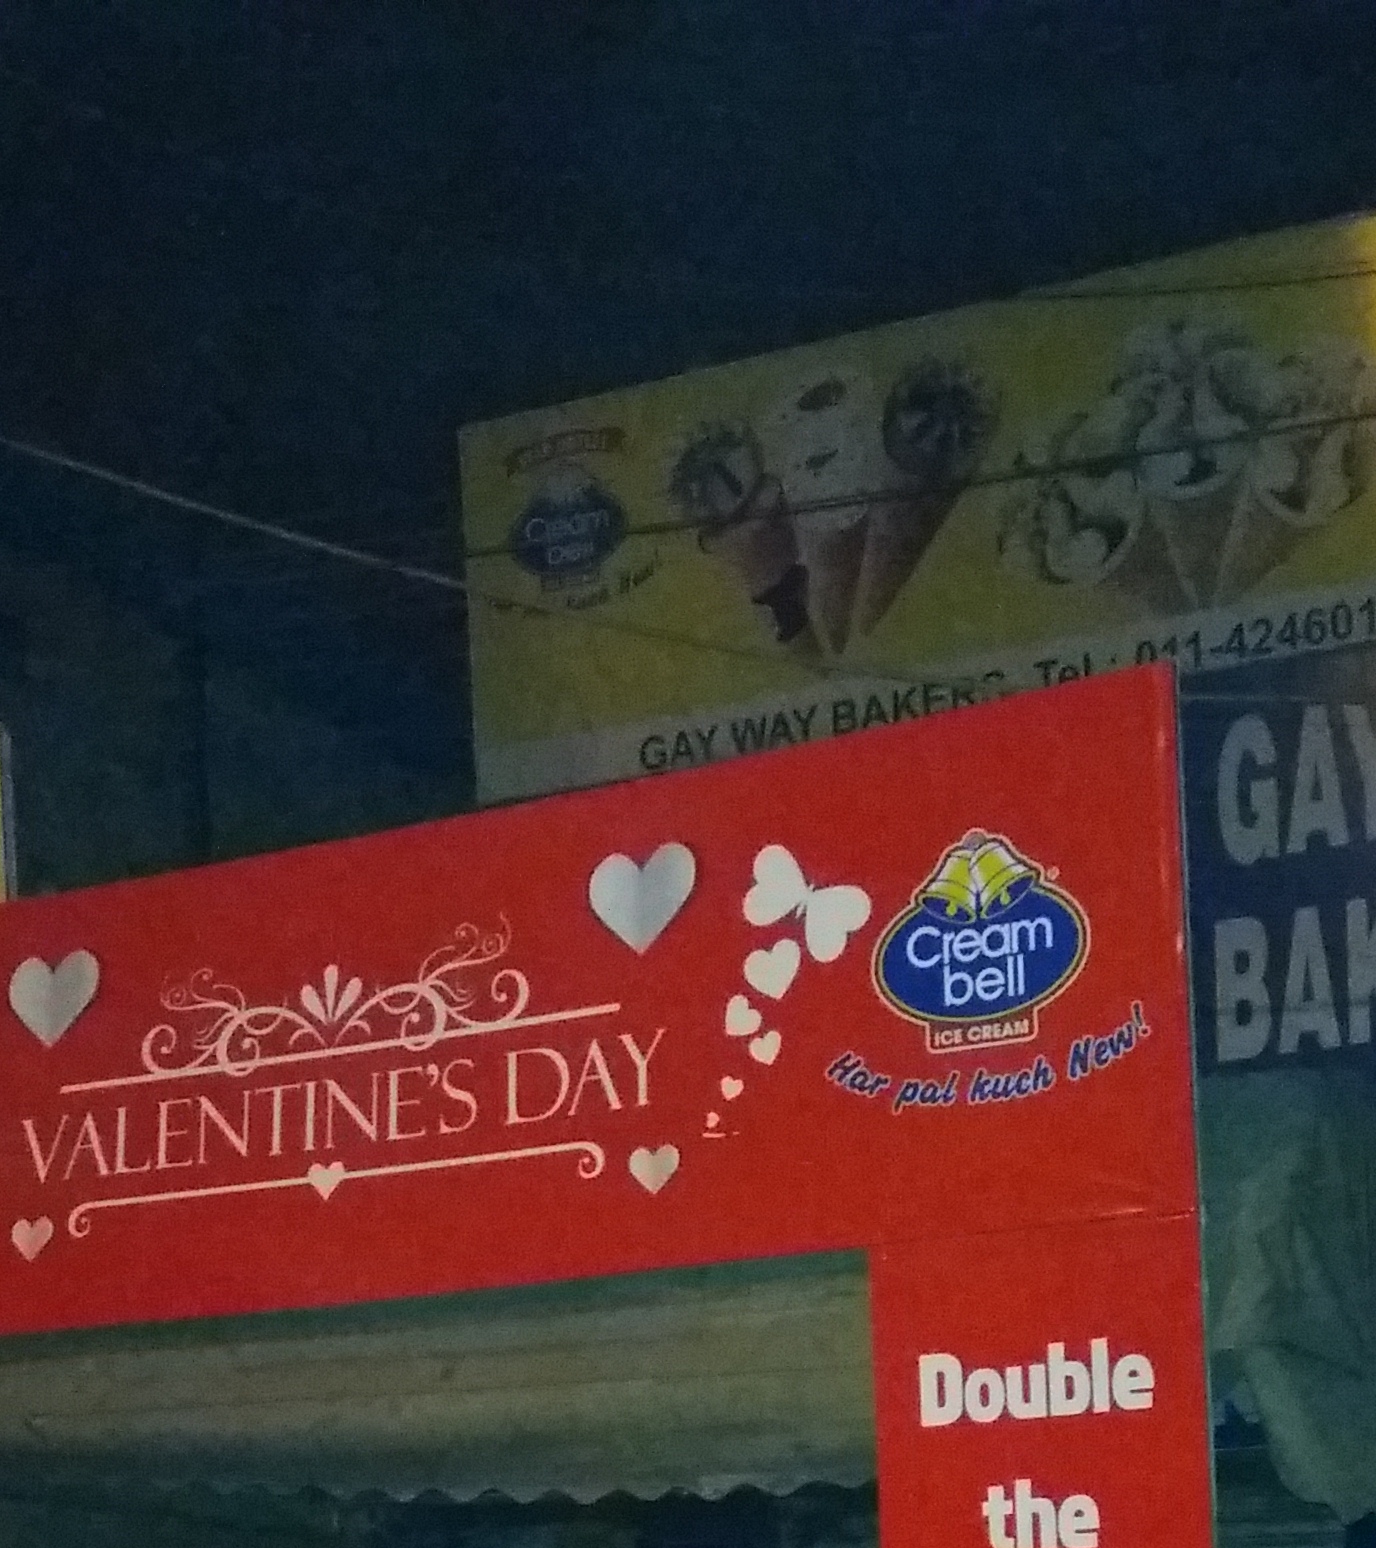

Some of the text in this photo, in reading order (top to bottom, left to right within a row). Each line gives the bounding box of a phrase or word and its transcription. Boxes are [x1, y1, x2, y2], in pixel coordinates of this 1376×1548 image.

[638, 723, 720, 771] GAY
[730, 705, 820, 756] WAY
[906, 916, 1054, 969] Cream
[943, 953, 1026, 1007] bell
[825, 1050, 890, 1098] Har
[967, 1054, 1056, 1106] kuch
[1066, 999, 1153, 1082] New!
[933, 1018, 1030, 1048] ICE CREAM
[20, 1027, 668, 1185] VALENTINE'S DAY
[918, 1336, 1156, 1428] Double
